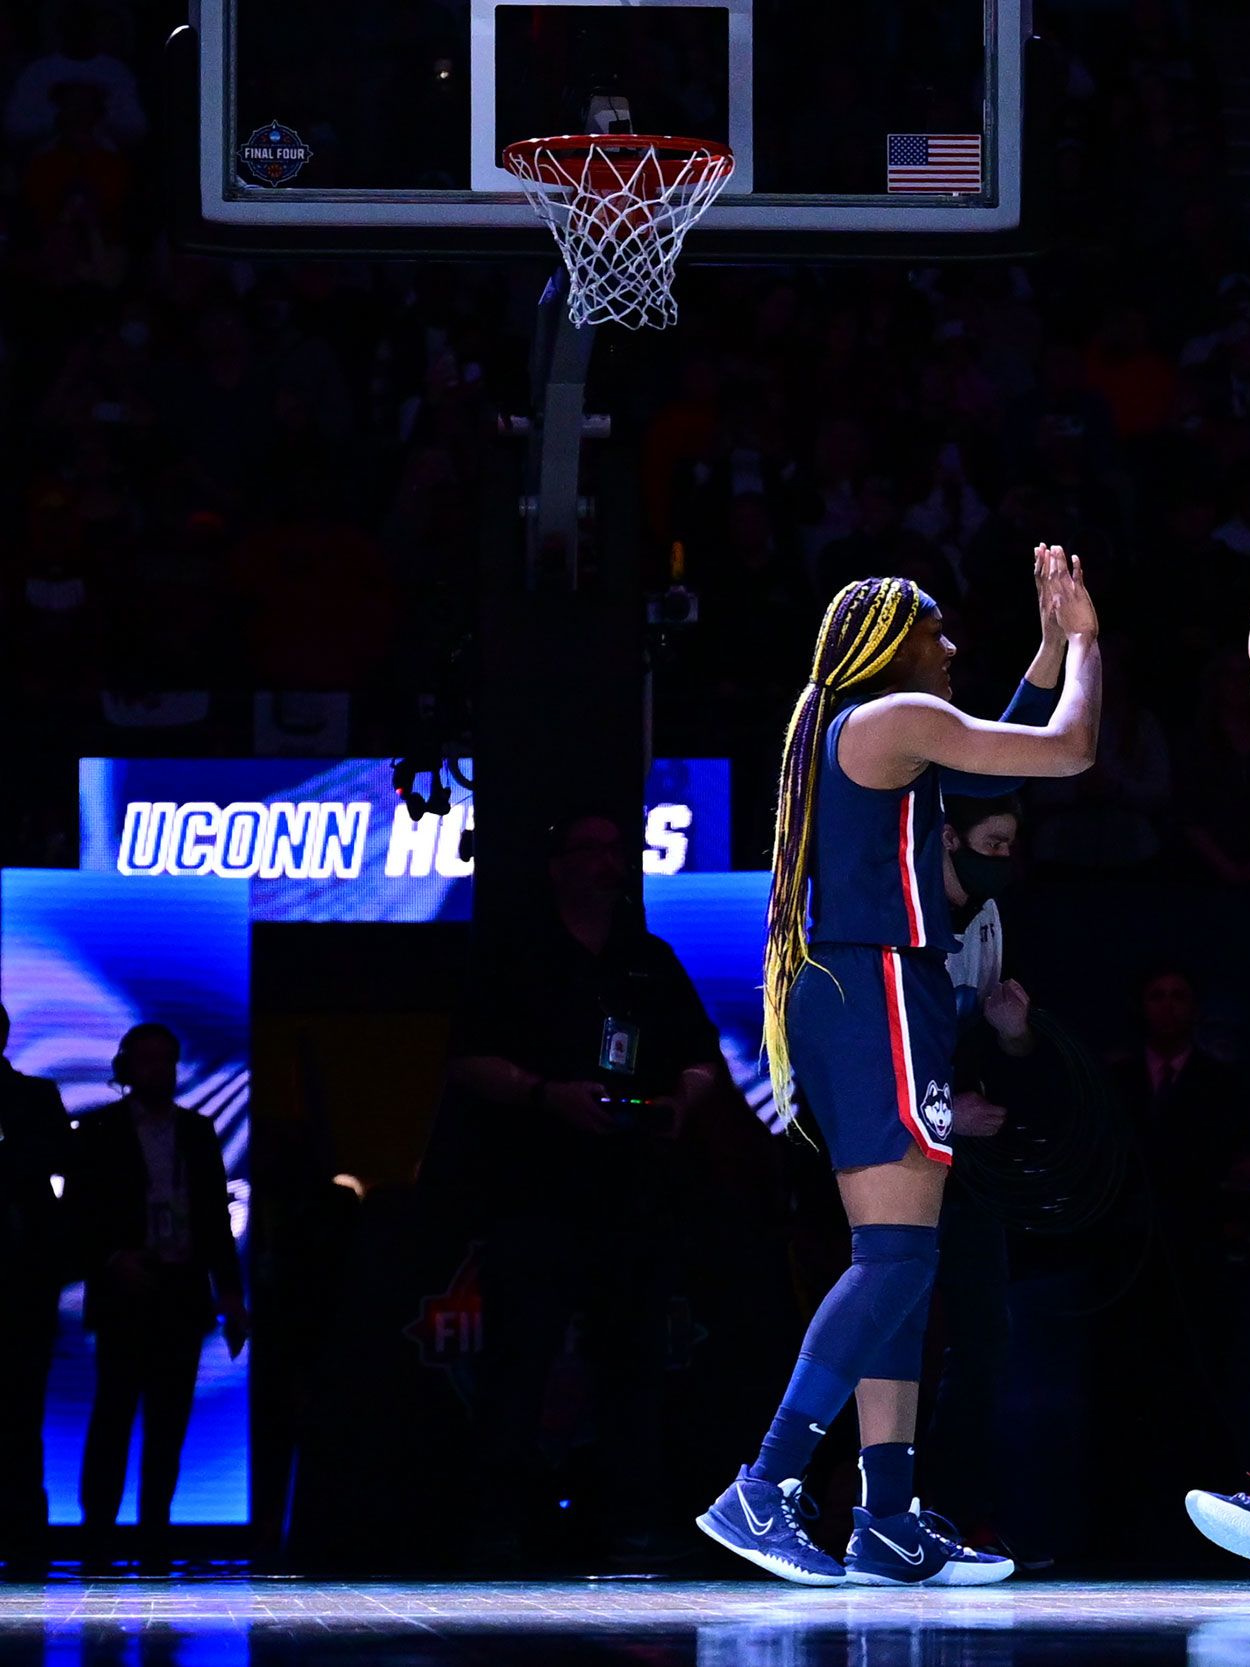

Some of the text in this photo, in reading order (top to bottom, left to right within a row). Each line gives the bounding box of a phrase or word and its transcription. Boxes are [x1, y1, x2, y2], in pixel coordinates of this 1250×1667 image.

[244, 147, 305, 160] FINAL FOUR
[116, 802, 372, 879] UCONN
